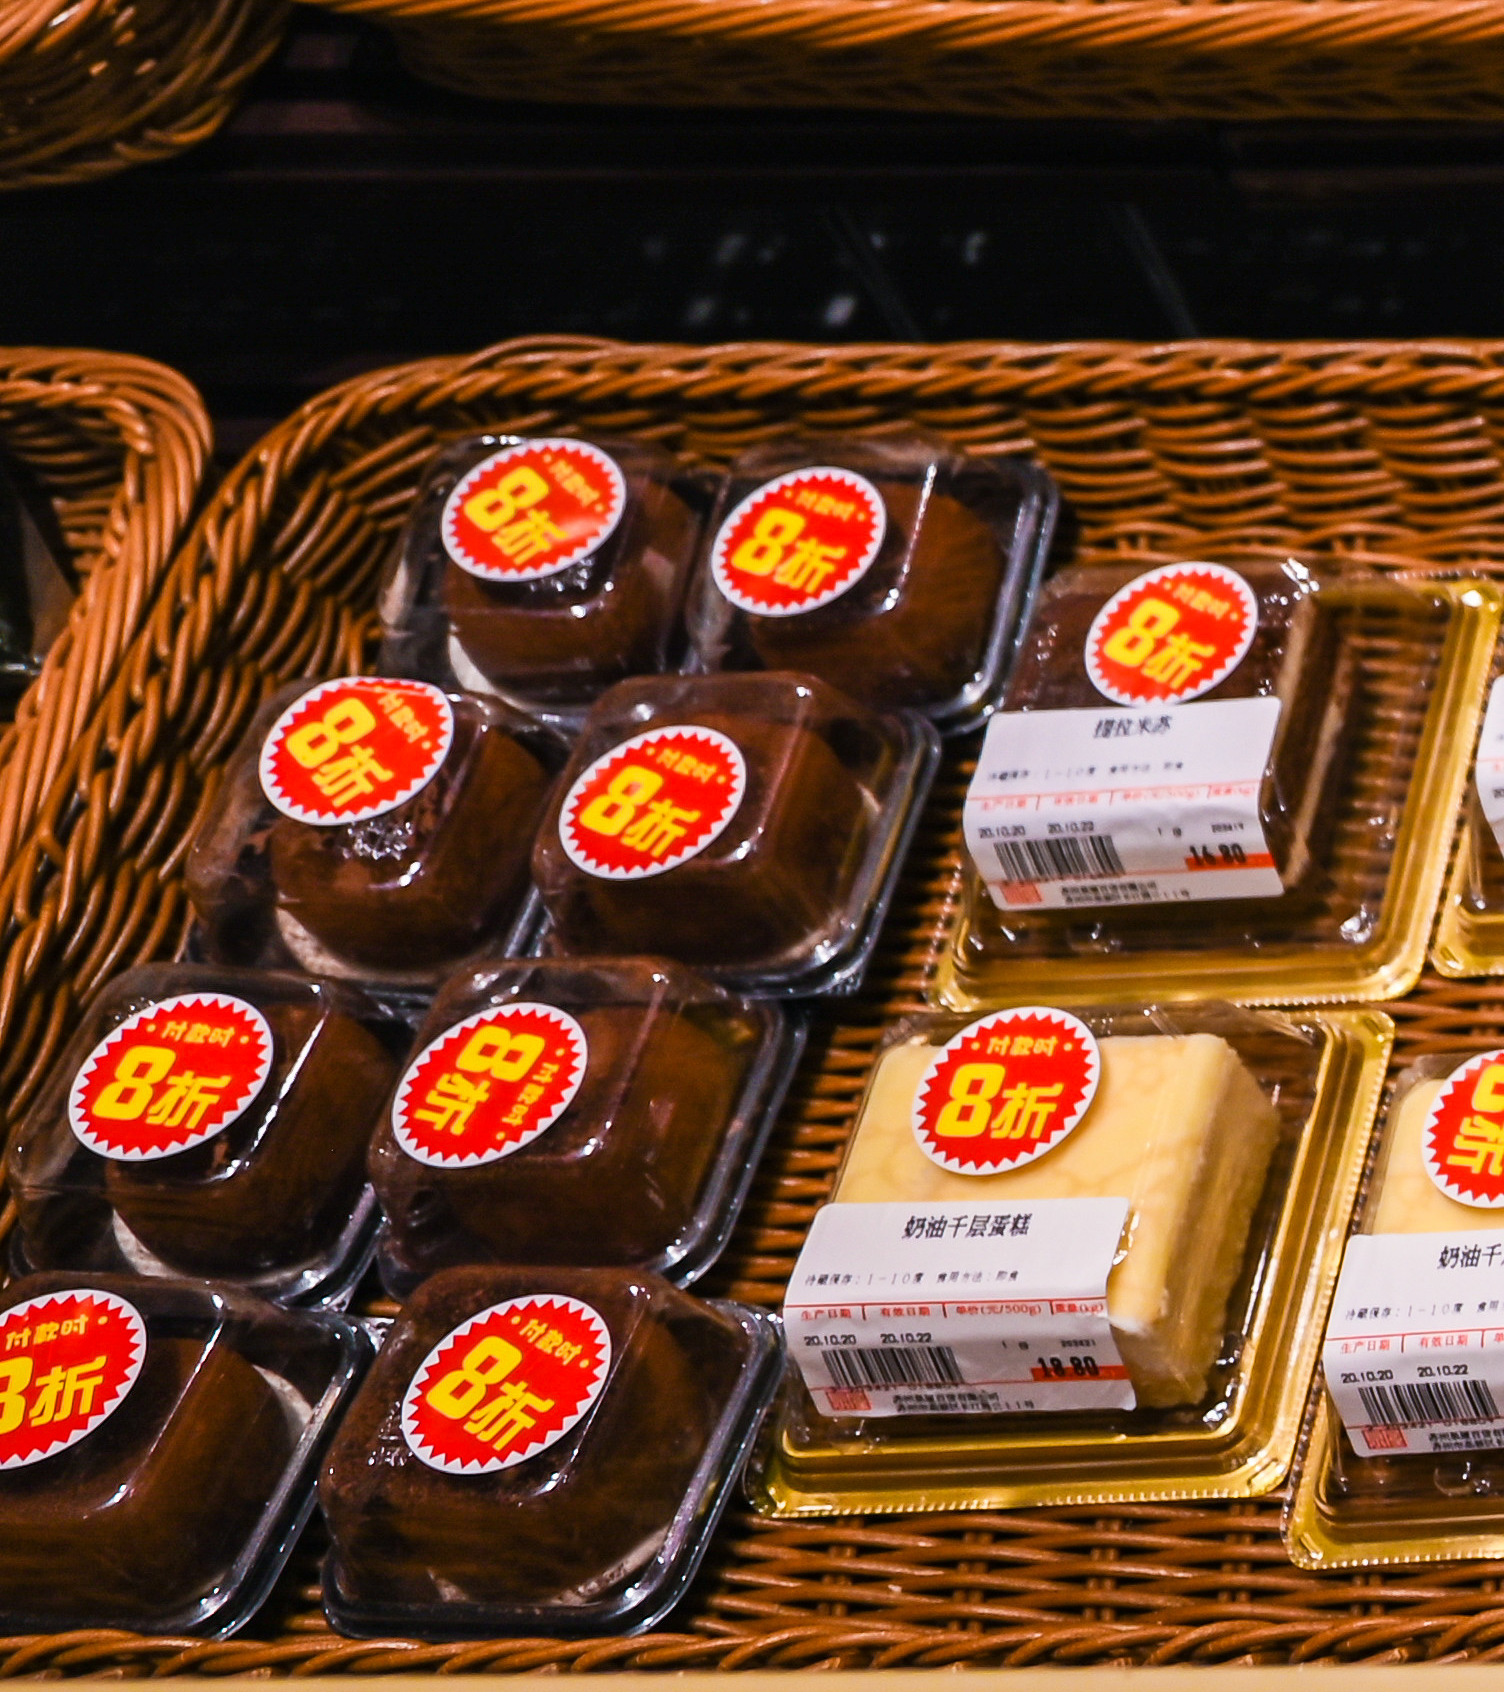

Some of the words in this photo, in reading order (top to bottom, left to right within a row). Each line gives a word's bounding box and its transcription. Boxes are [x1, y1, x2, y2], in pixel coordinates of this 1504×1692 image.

[462, 463, 568, 567] 8折
[730, 506, 847, 596] 8折
[1102, 597, 1217, 691] 8折
[286, 697, 395, 808] 8折
[578, 764, 700, 860] 8折
[159, 1018, 236, 1047] 付款时
[986, 1034, 1060, 1058] 付款时
[91, 1044, 233, 1130] 8折
[413, 1022, 547, 1137] 8折
[934, 1062, 1064, 1140] 8折
[901, 1211, 1034, 1242] 奶油千层蛋糕
[4, 1312, 89, 1350] 付款时
[519, 1315, 584, 1368] 付款时
[803, 1333, 857, 1347] 20.10.20
[880, 1331, 933, 1344] 20.10.22
[1340, 1338, 1391, 1354] 生产日期
[1419, 1333, 1469, 1349] 有效日期
[443, 1334, 556, 1453] 8折
[1340, 1369, 1394, 1384] 20.10.20
[1416, 1364, 1469, 1378] 20.10.22
